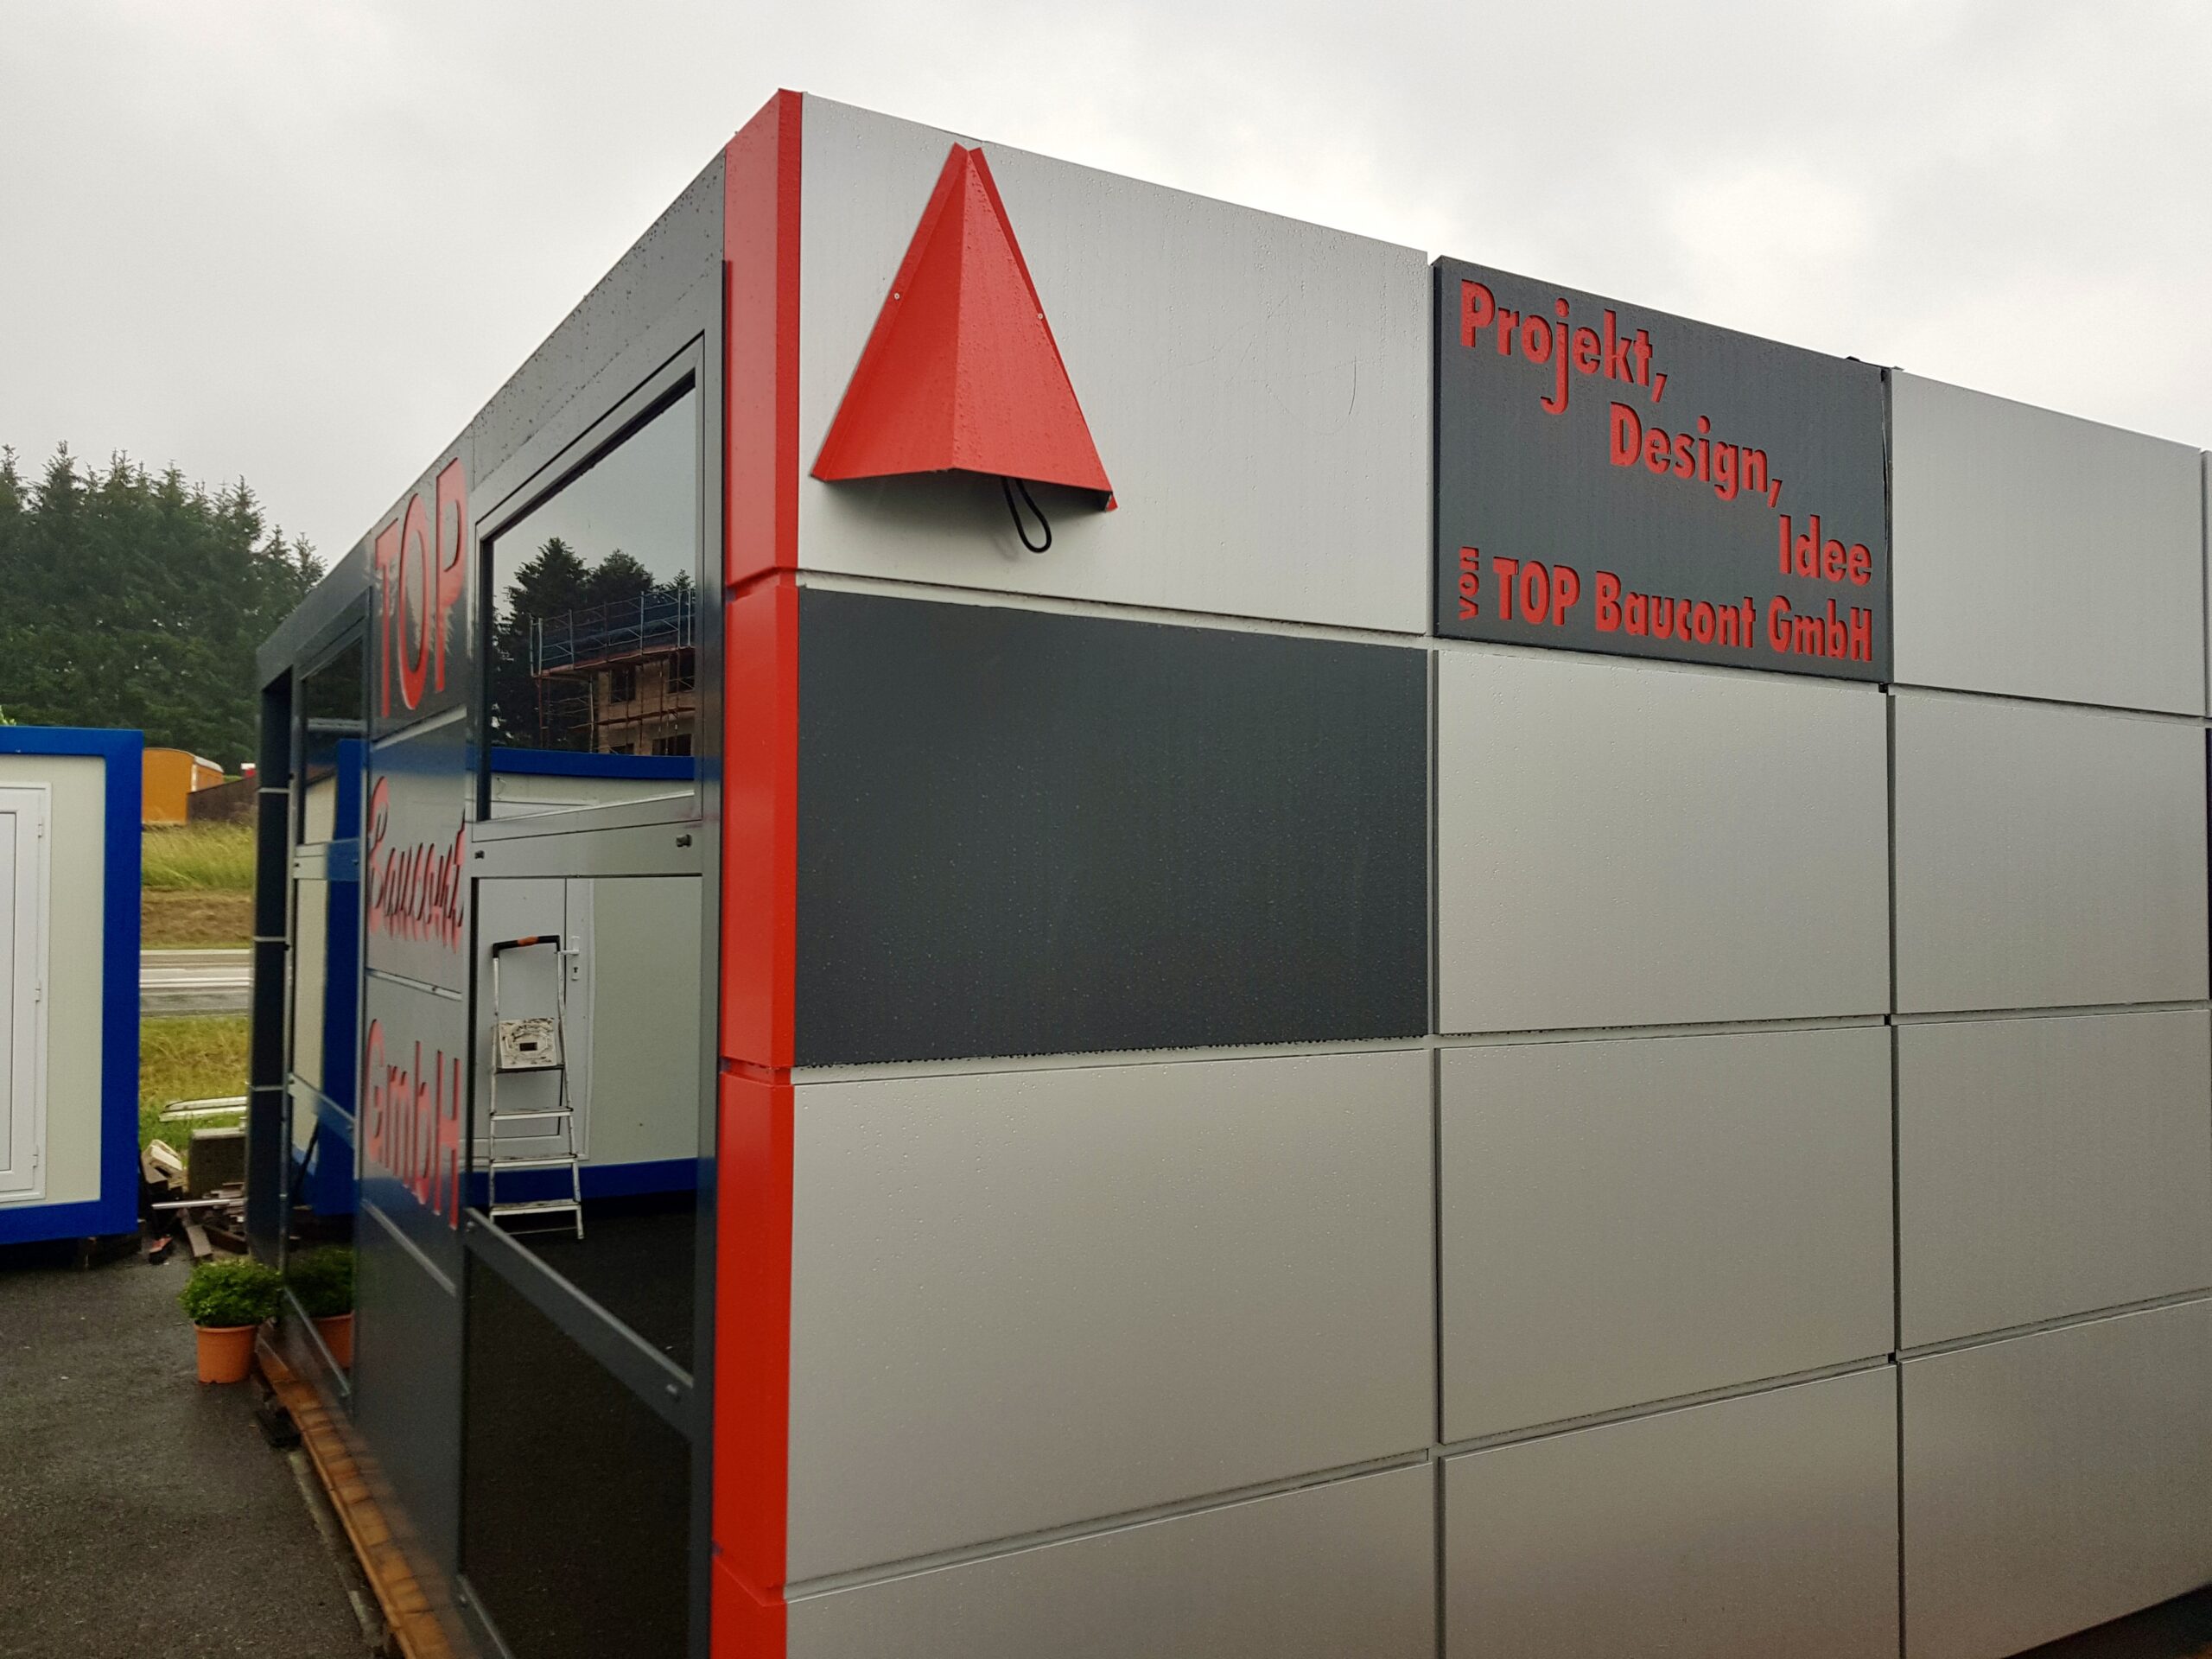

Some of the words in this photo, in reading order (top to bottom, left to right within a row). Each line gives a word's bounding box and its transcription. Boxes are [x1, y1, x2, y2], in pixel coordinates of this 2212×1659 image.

[1459, 278, 1668, 415] Projekt,
[1609, 401, 1783, 509] Design,
[375, 456, 467, 718] TOP
[1458, 546, 1480, 621] von
[1492, 556, 1580, 626] TOP
[1595, 570, 1756, 649] Baucont
[1768, 594, 1872, 663] GmbH
[1778, 513, 1872, 586] Idee
[365, 1019, 461, 1230] GmbH
